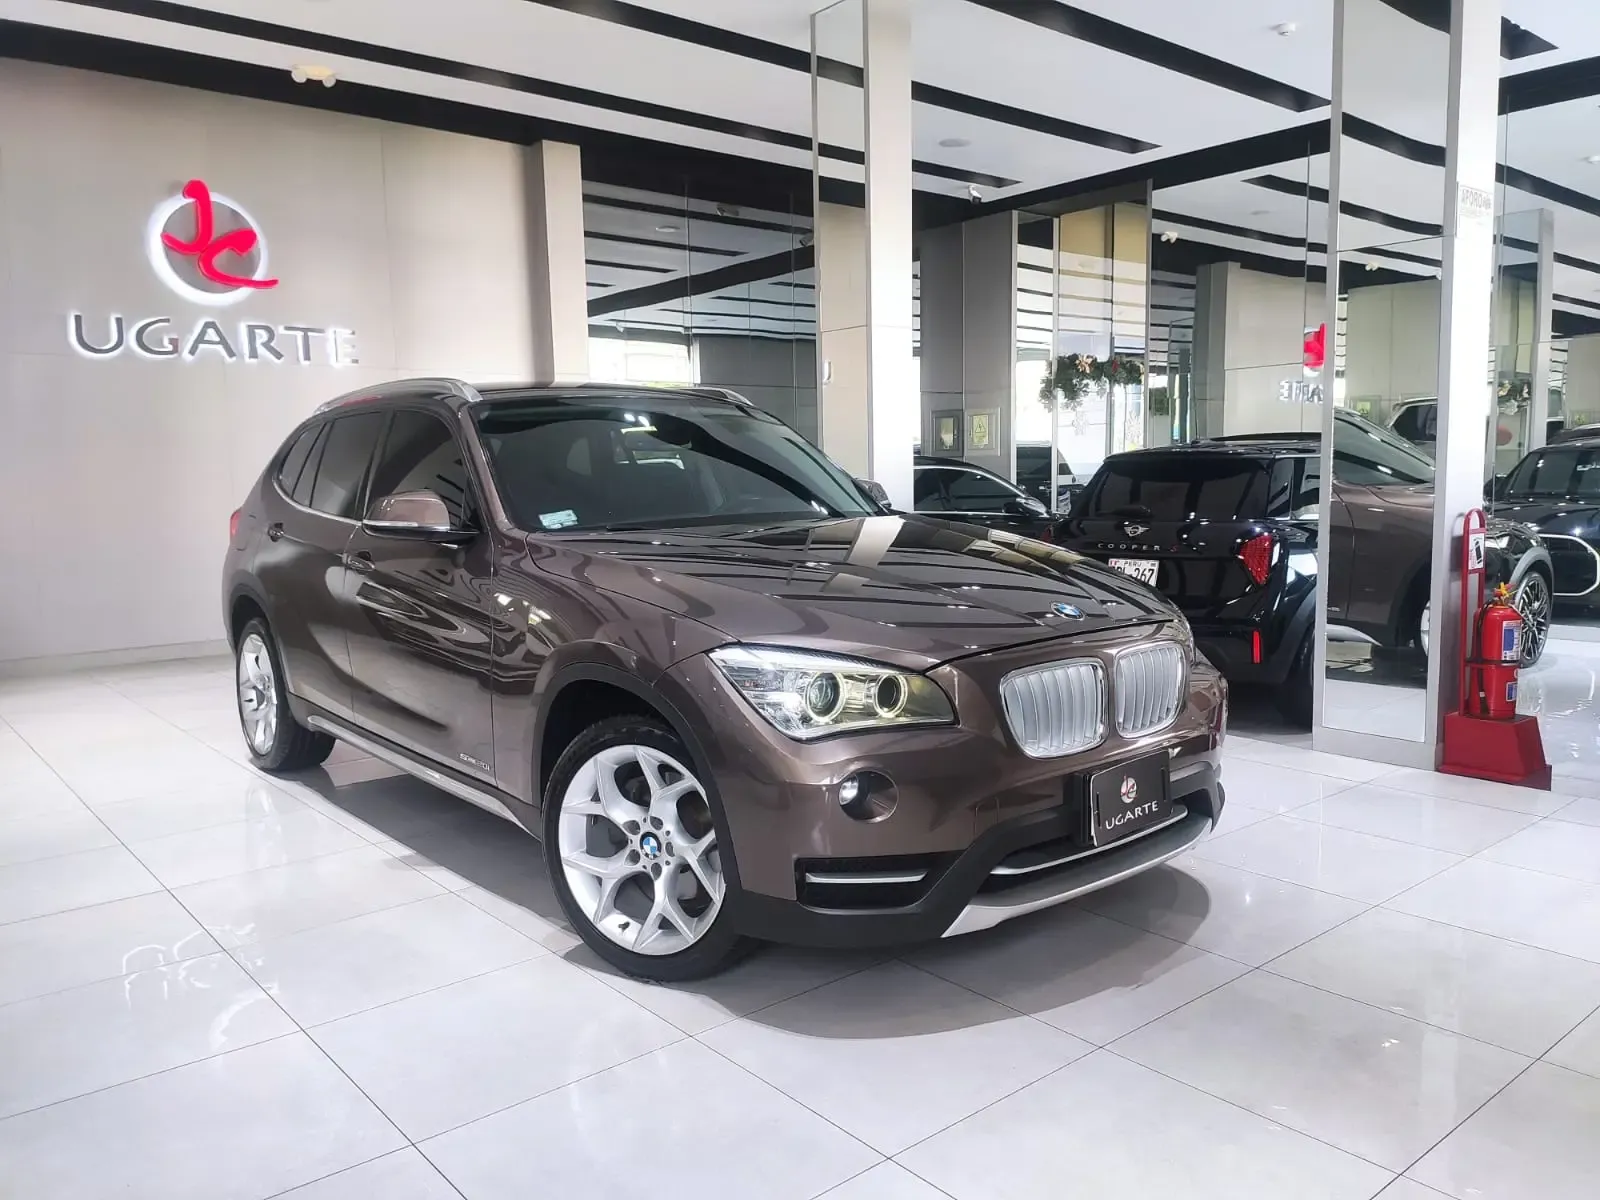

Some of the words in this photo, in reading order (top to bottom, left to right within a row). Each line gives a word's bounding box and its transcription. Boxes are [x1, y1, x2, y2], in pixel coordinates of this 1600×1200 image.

[71, 313, 360, 365] UGARTE
[1097, 542, 1161, 551] COOPER
[1105, 800, 1159, 830] UGARTE
